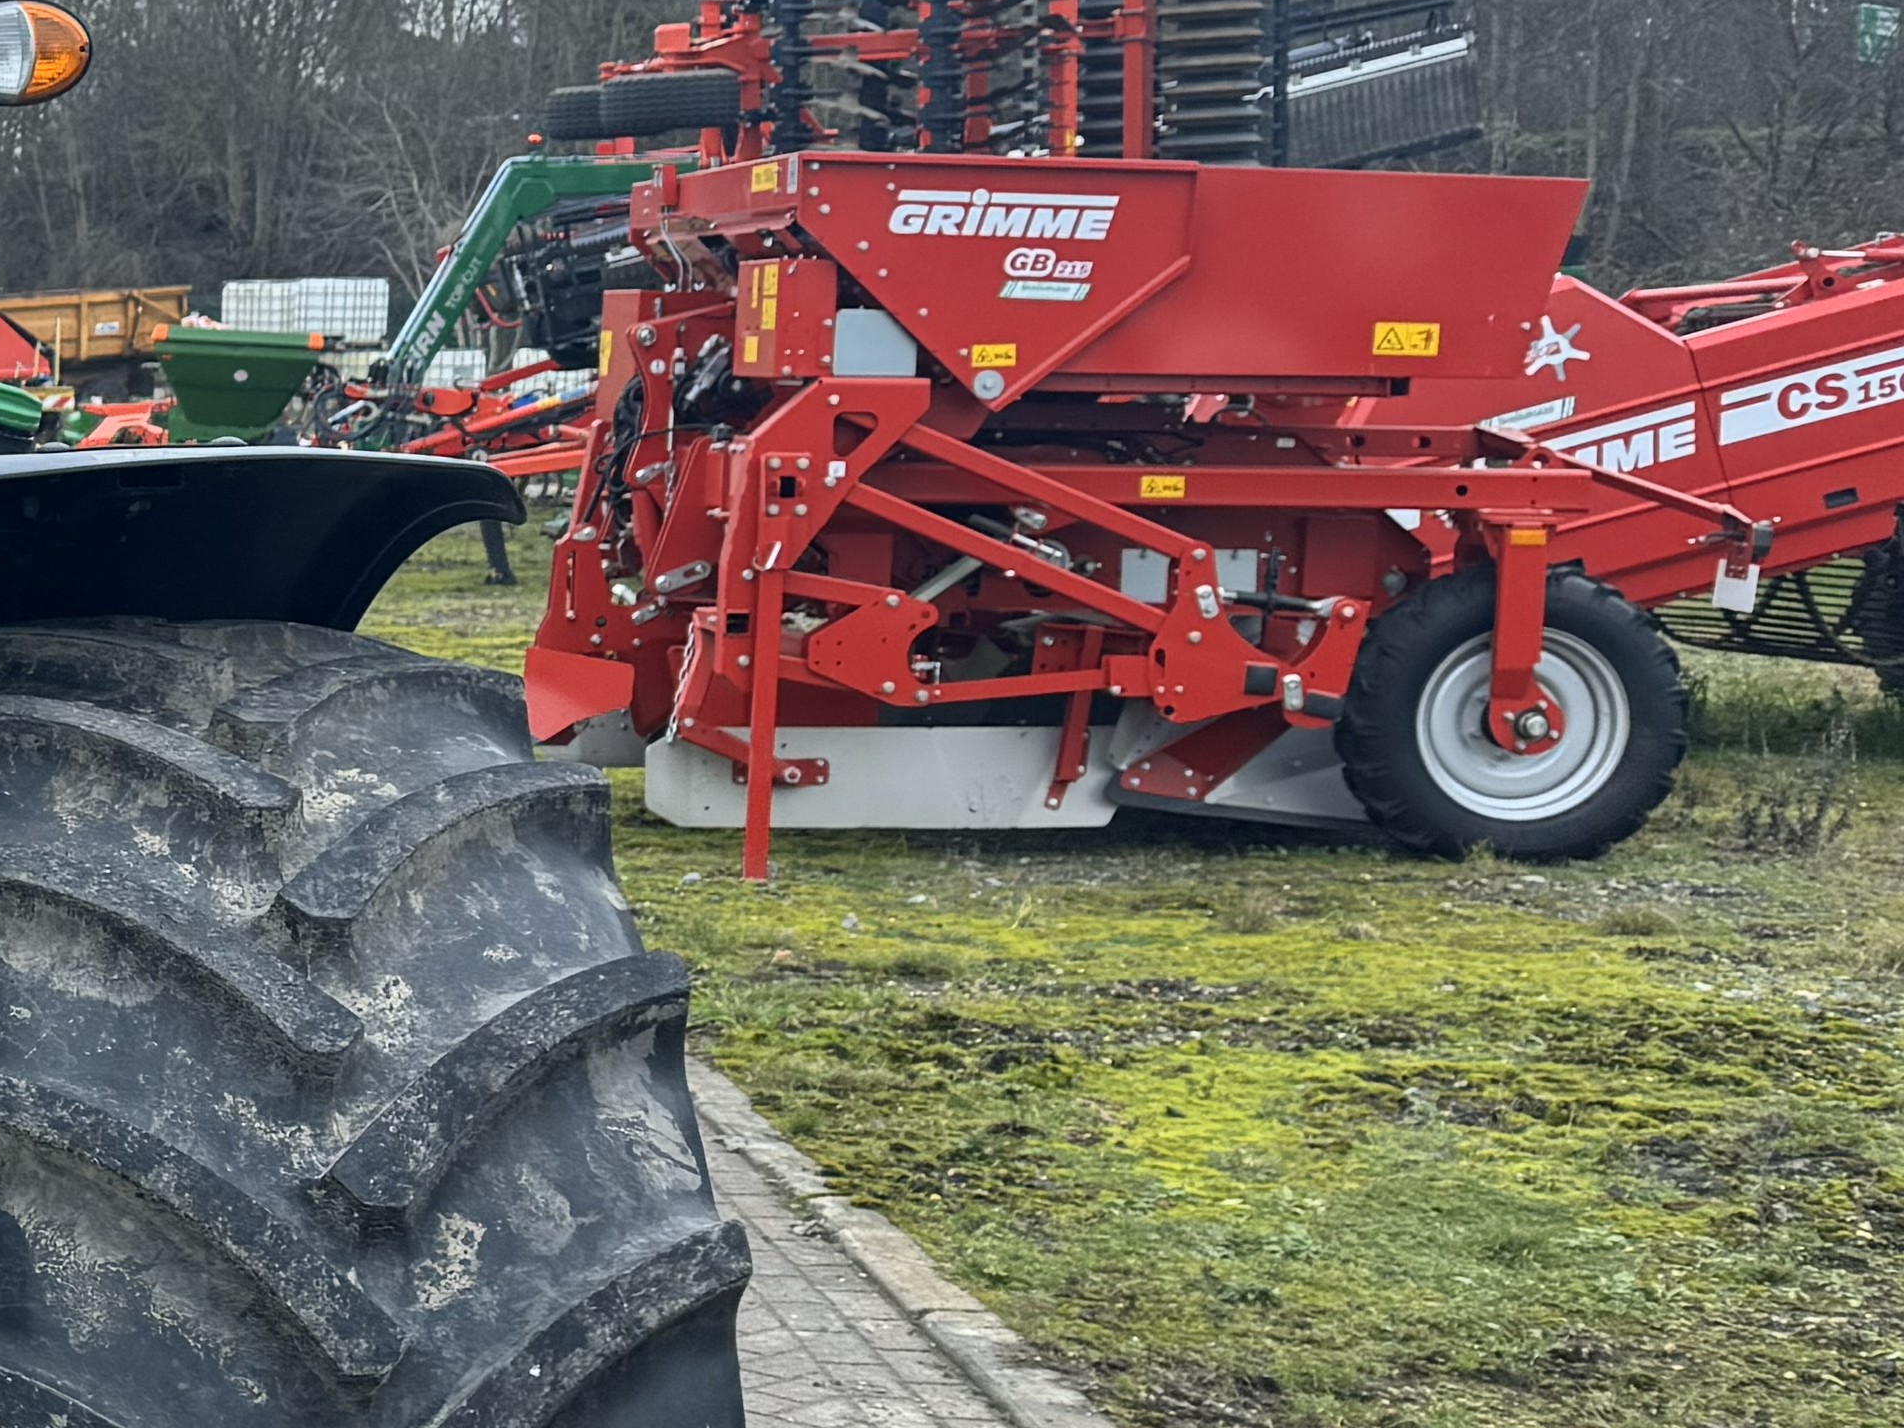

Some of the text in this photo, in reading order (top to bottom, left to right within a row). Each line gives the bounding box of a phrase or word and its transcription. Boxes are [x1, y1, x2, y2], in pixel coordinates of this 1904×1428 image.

[889, 188, 1116, 240] GRIMME
[1009, 252, 1051, 272] GB
[1777, 372, 1904, 421] CS 15
